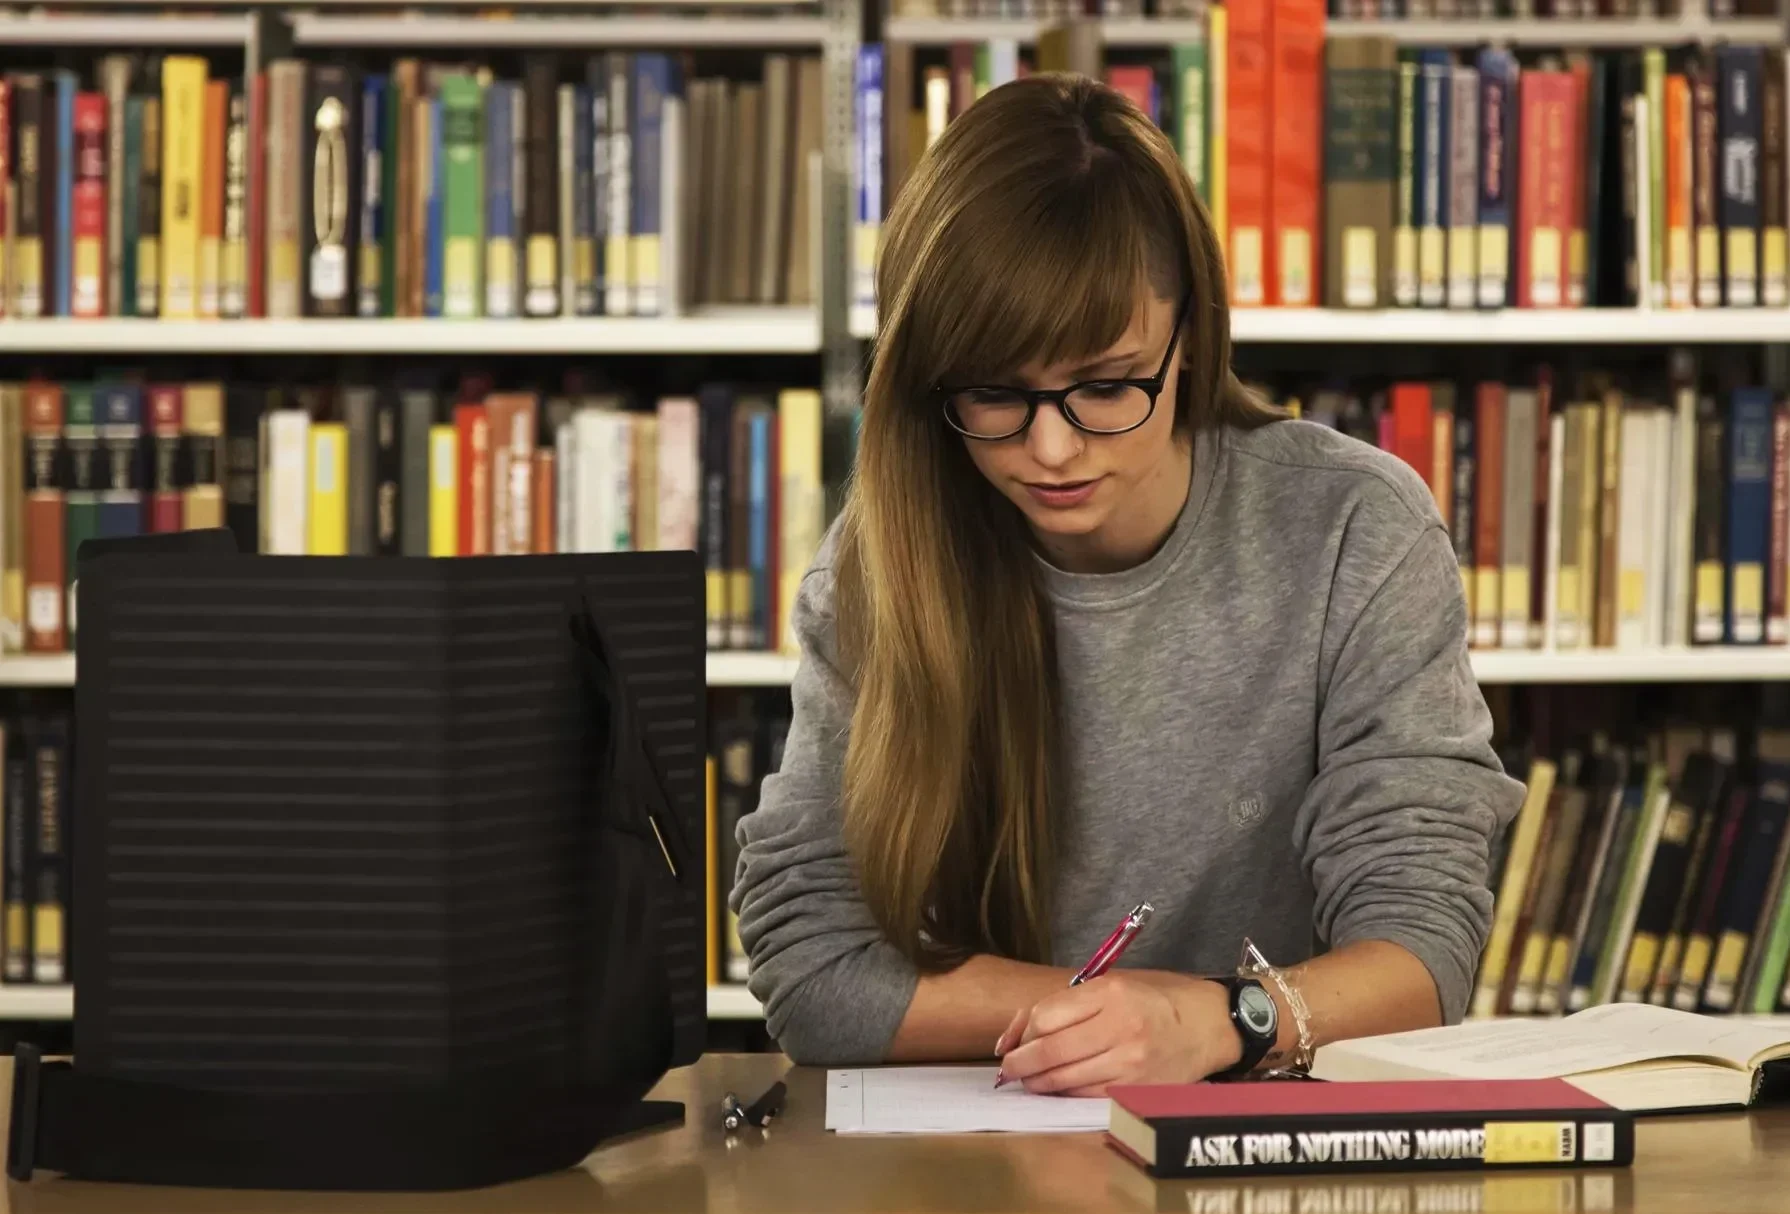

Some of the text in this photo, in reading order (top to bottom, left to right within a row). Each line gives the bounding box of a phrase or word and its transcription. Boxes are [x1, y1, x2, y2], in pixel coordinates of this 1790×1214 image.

[1184, 1135, 1241, 1168] ASK
[1241, 1132, 1294, 1166] FOR
[1295, 1130, 1411, 1163] NOTHING
[1413, 1128, 1485, 1160] MORE
